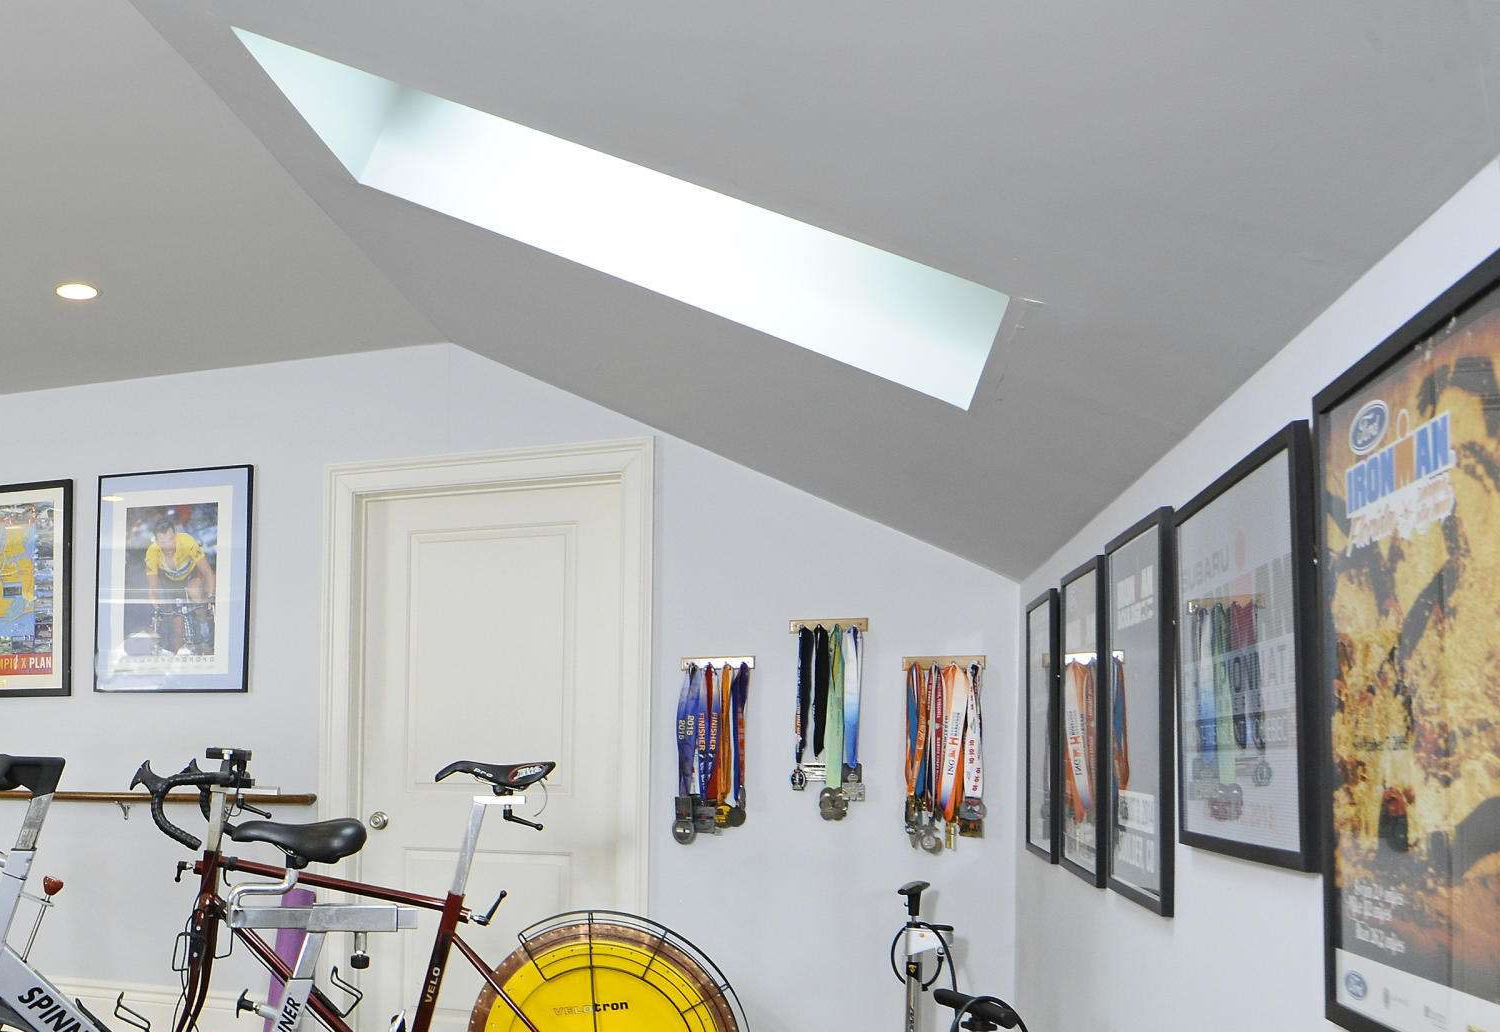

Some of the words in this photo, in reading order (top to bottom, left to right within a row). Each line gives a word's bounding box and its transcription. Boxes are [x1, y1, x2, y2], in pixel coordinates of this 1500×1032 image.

[1346, 413, 1451, 515] IRONMAN
[20, 658, 27, 669] X
[29, 656, 52, 669] PLAN
[698, 712, 706, 751] FINISHER
[709, 711, 718, 750] FINISHER
[947, 759, 956, 776] ING
[424, 966, 441, 1003] VELO
